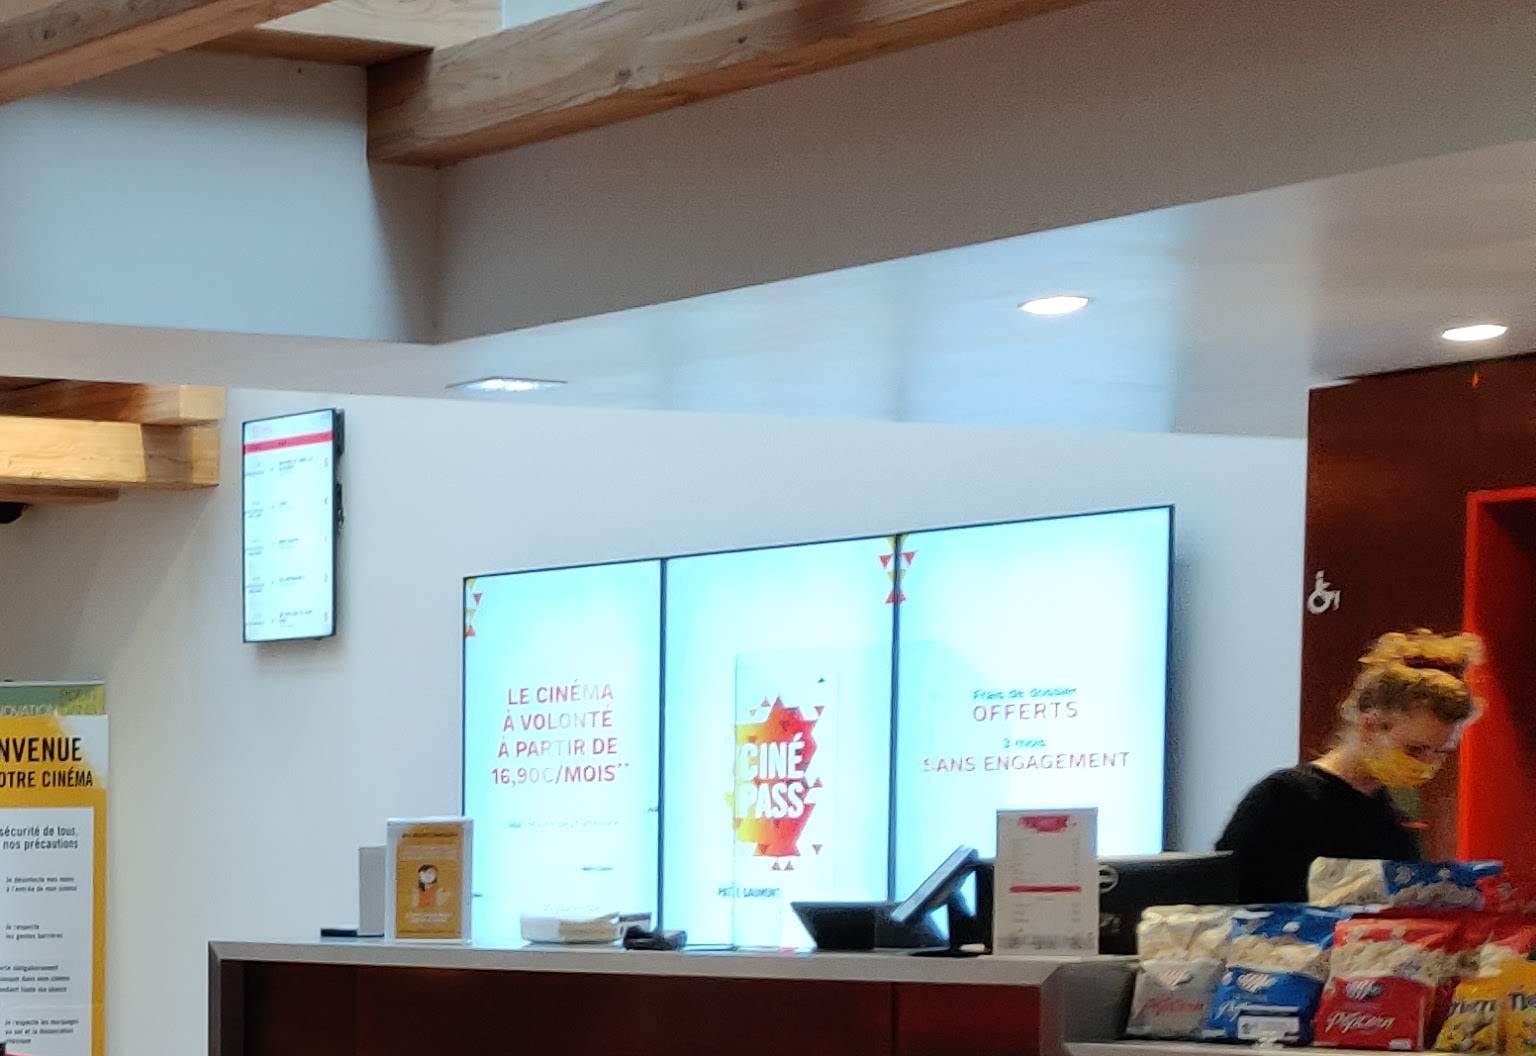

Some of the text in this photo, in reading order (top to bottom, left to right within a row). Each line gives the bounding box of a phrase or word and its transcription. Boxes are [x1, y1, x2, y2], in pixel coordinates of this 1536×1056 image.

[507, 678, 614, 705] LE CINÉMA
[503, 703, 613, 732] À VOLONTÉ
[972, 700, 1079, 722] OFFERTS
[497, 735, 618, 758] À PARTIR DE
[739, 732, 806, 780] CINÉ
[923, 751, 1130, 773] SANS ENGAGEMENT
[42, 766, 93, 788] CINÉMA
[738, 781, 806, 819] PASS
[0, 824, 40, 837] sécurité
[43, 825, 55, 837] de
[3, 840, 21, 850] nos
[24, 838, 79, 851] précautions
